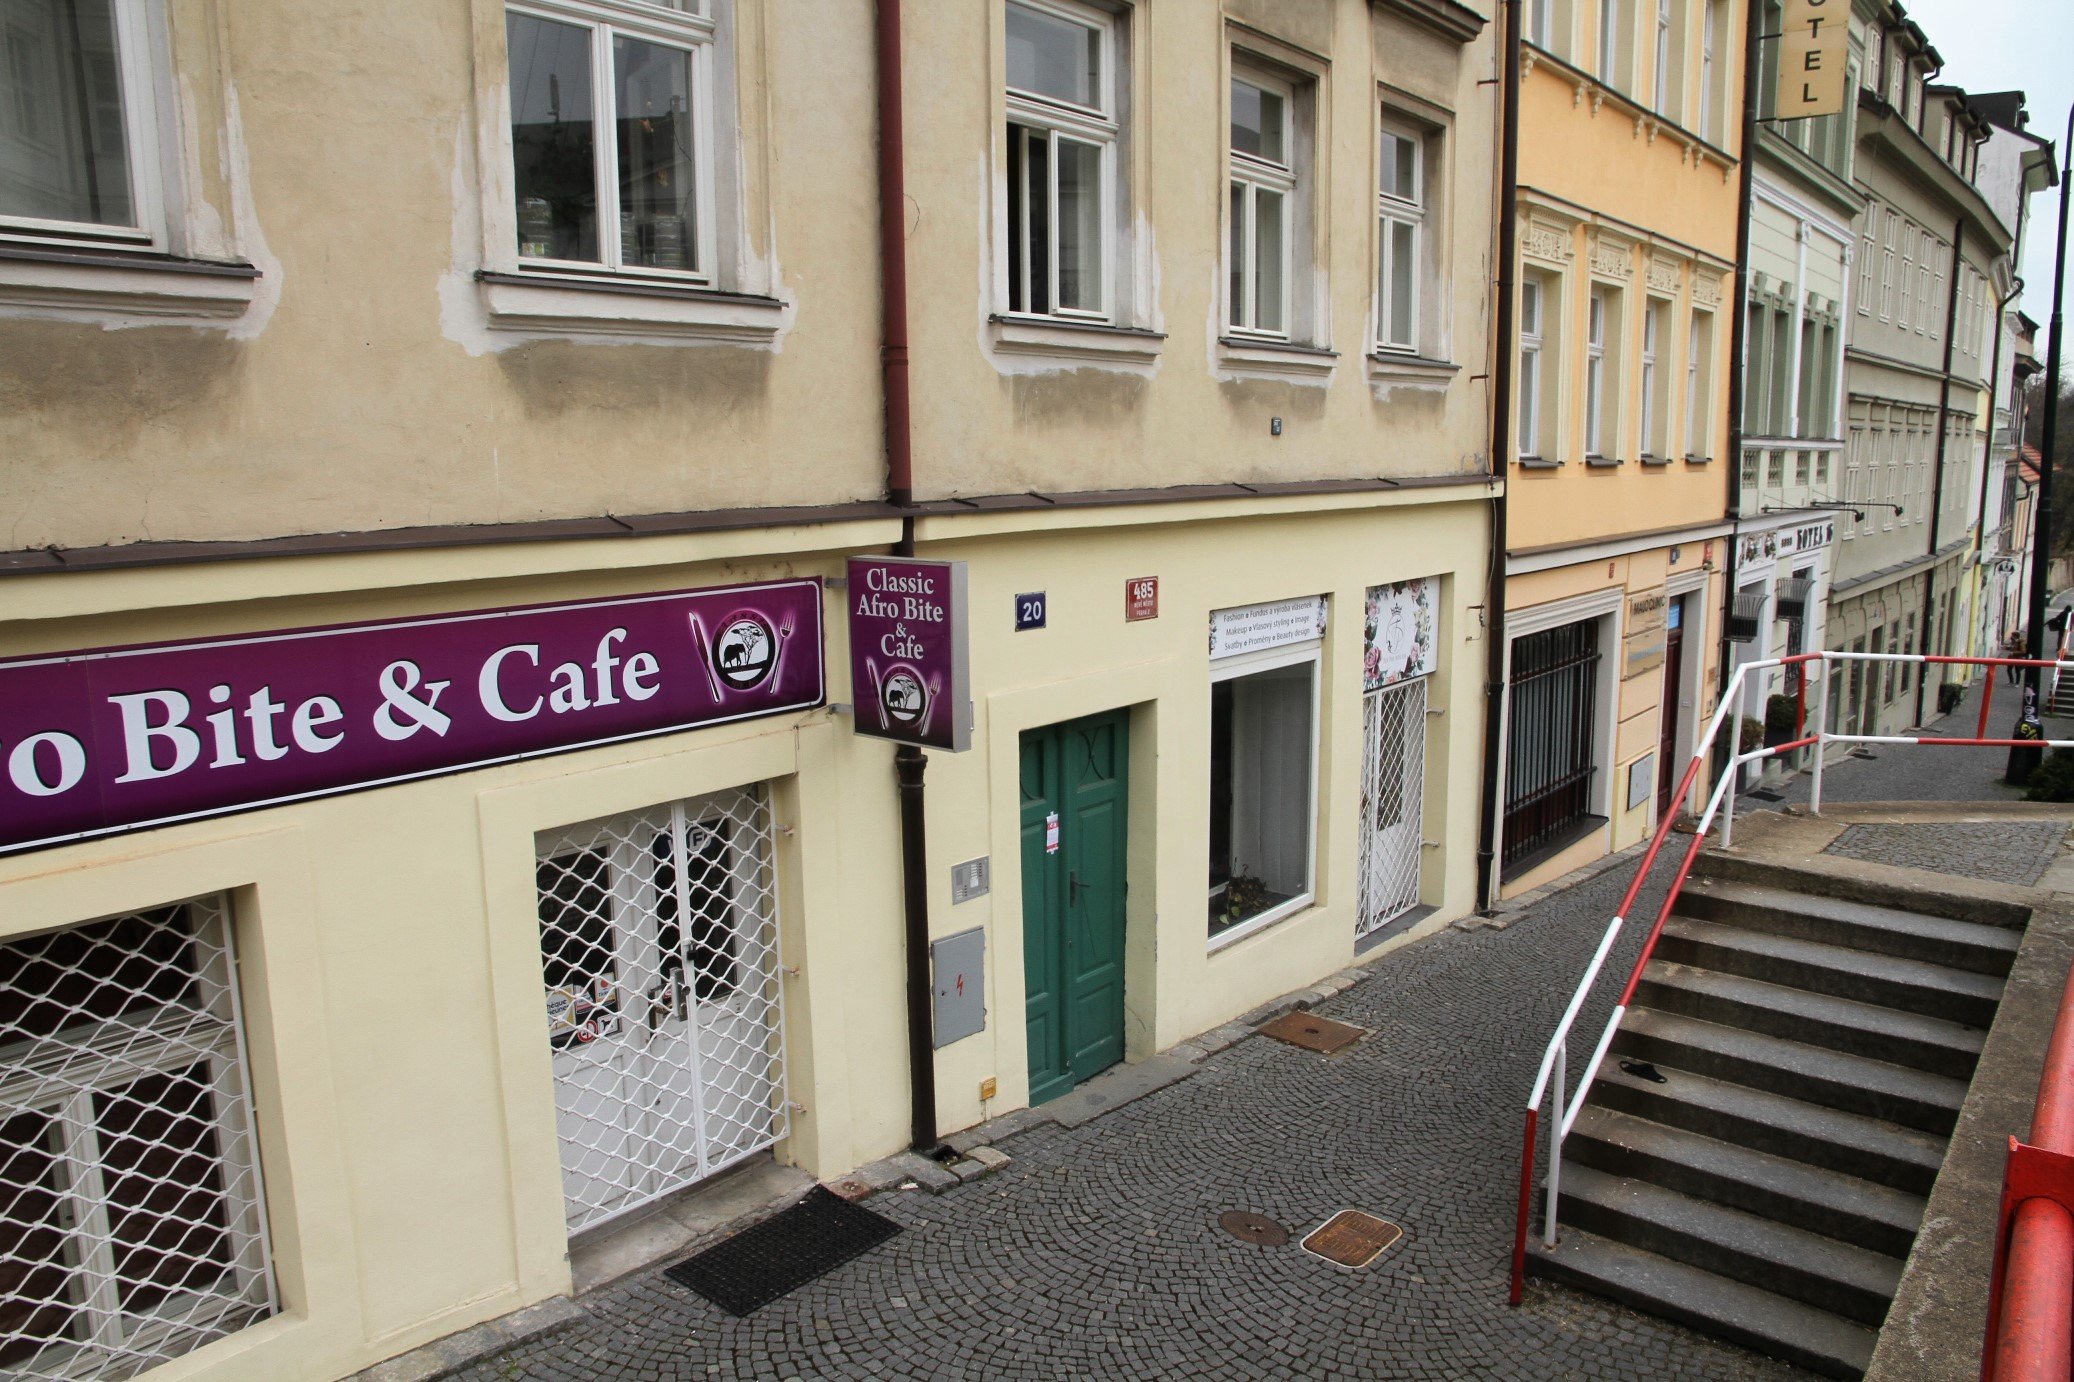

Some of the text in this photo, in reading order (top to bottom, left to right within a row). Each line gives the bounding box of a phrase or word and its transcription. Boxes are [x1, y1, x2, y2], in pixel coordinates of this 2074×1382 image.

[866, 568, 934, 594] Classic
[1133, 581, 1154, 600] 485
[856, 593, 943, 622] Afro Bite
[1023, 601, 1042, 622] 20
[1223, 611, 1245, 622] Fashion
[1250, 608, 1268, 618] Fundus
[895, 622, 907, 638] &
[1226, 626, 1248, 636] Makeup
[1273, 617, 1290, 628] styling
[1294, 615, 1310, 624] Image
[880, 634, 924, 660] Cafe
[1224, 640, 1242, 651] Svatby
[1276, 630, 1293, 641] Beauty
[1294, 627, 1311, 638] design
[106, 684, 345, 784] Bite
[372, 660, 451, 741] &
[478, 627, 661, 722] Cafe
